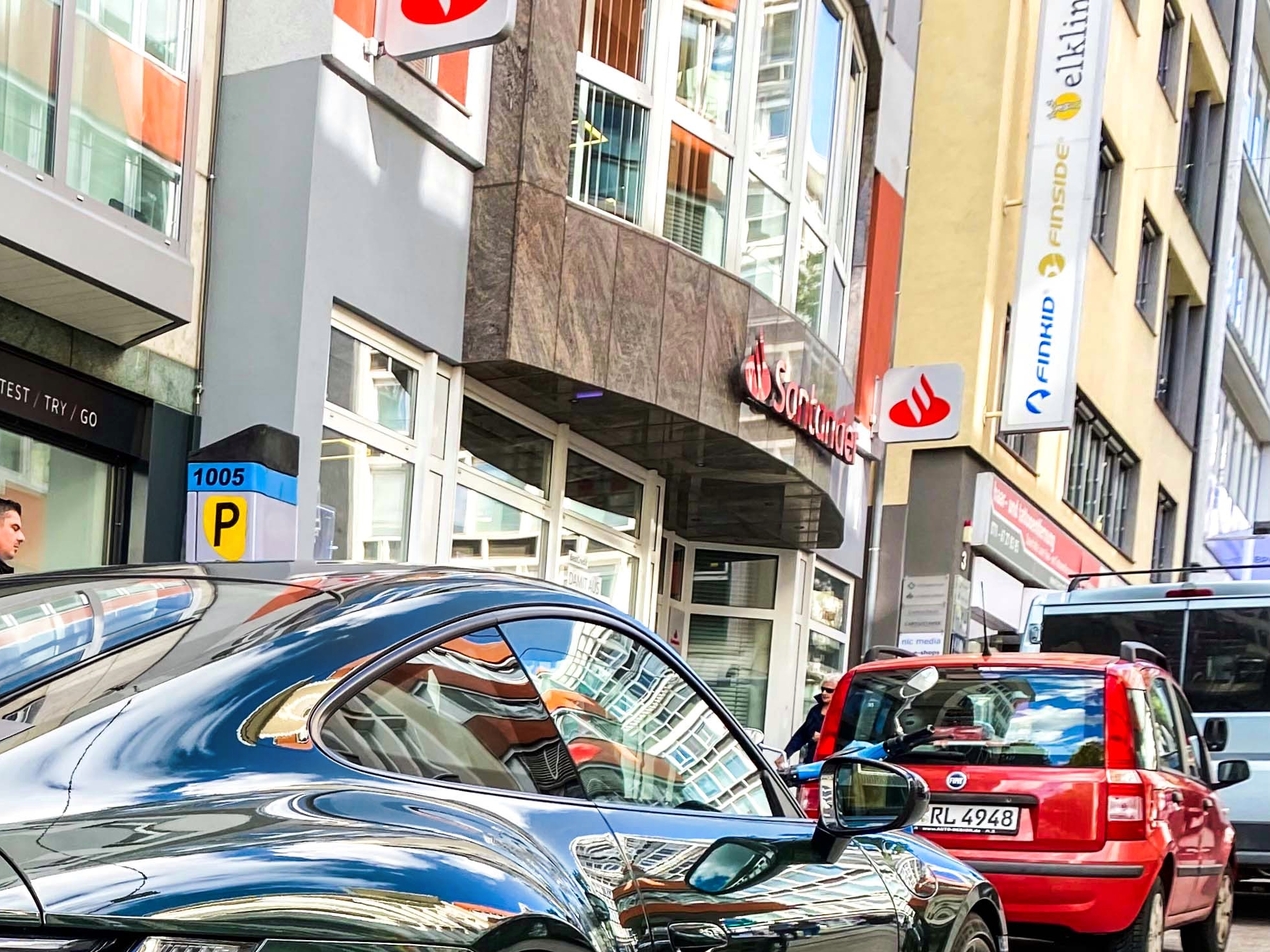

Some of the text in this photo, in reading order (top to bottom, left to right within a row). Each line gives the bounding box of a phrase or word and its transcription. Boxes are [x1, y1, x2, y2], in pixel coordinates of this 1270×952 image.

[1036, 296, 1055, 384] FINKID
[0, 378, 30, 403] TEST
[44, 394, 68, 416] TRY
[80, 408, 98, 427] GO
[773, 359, 858, 465] Santander
[193, 467, 245, 486] 1005
[213, 502, 240, 547] P
[961, 551, 967, 571] 3
[930, 807, 1013, 827] RL 4948
